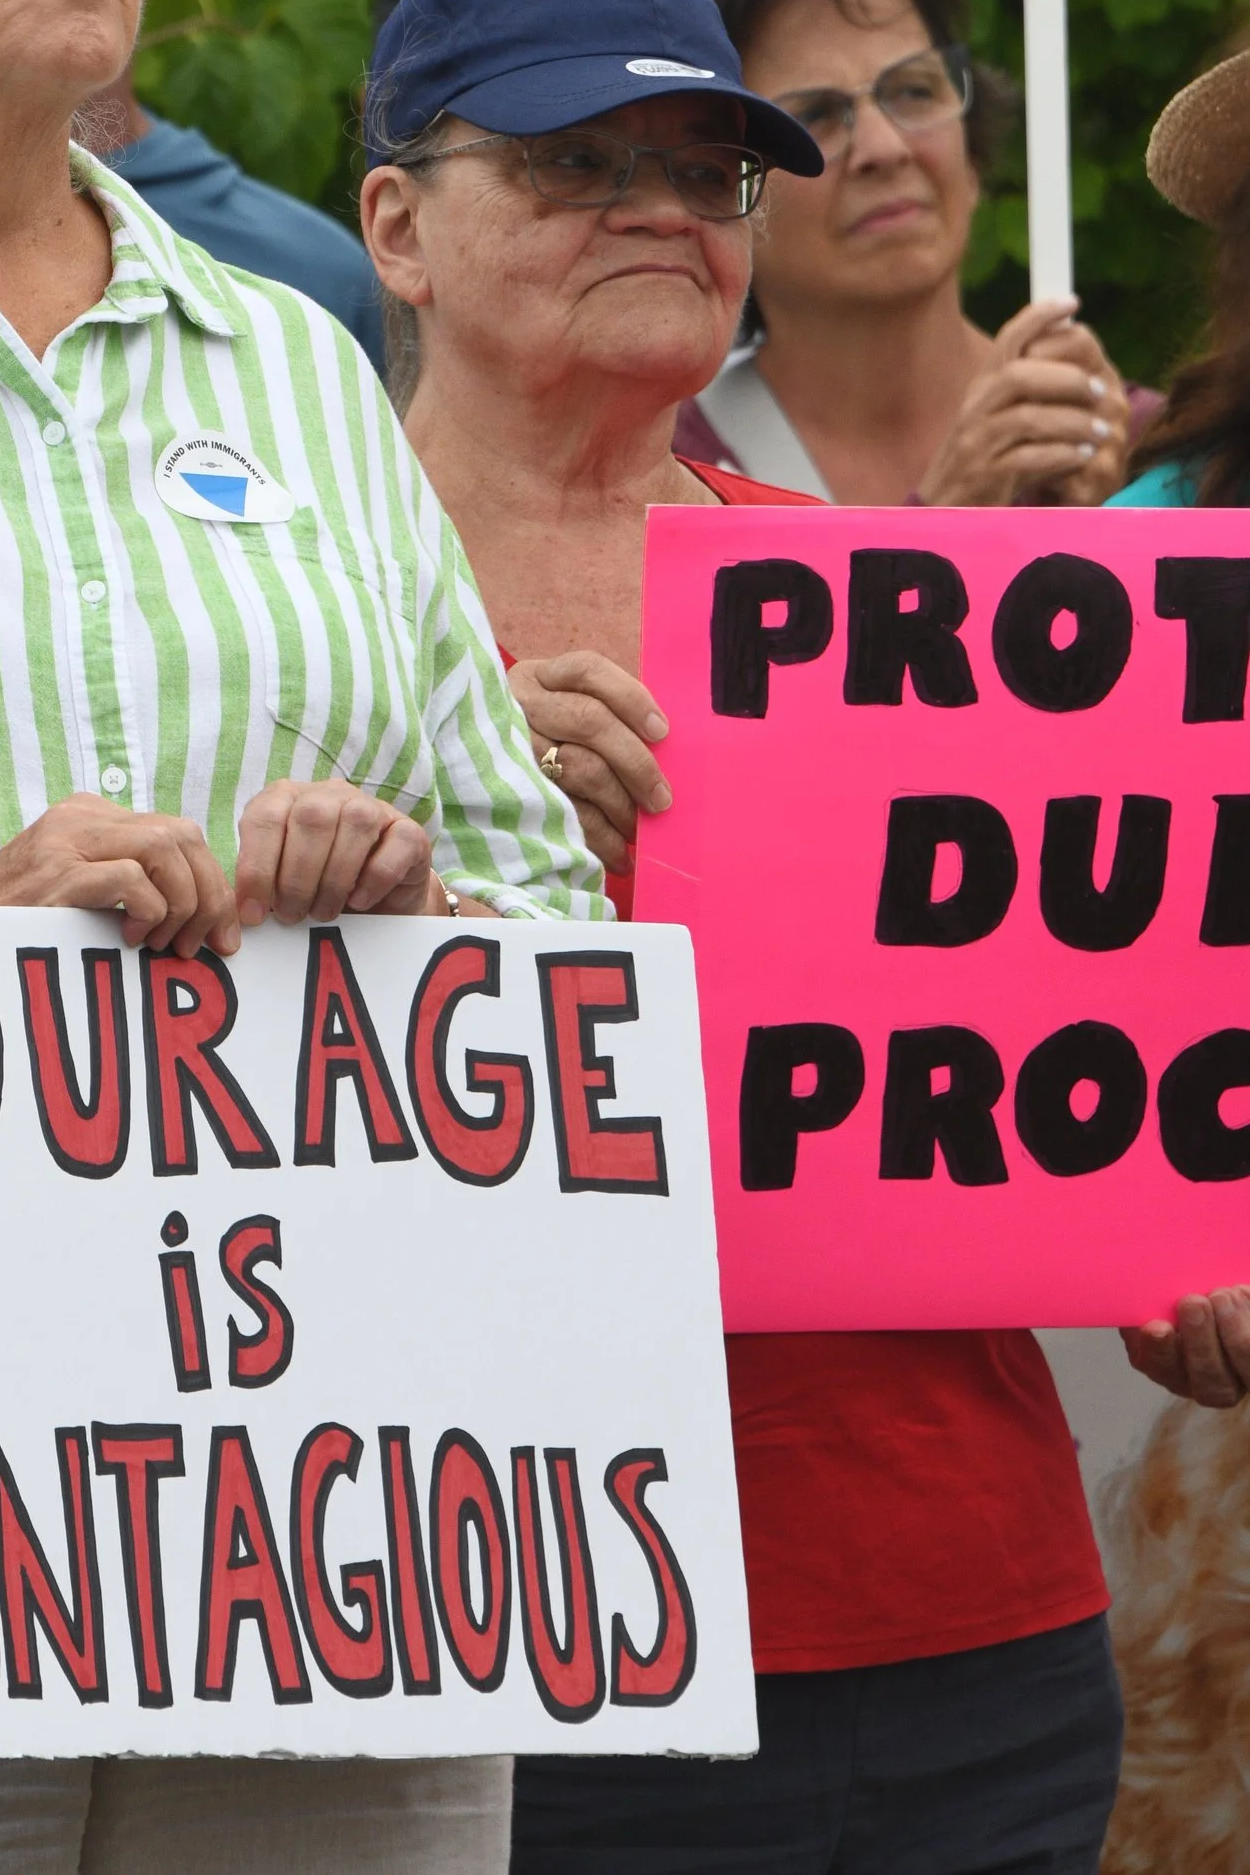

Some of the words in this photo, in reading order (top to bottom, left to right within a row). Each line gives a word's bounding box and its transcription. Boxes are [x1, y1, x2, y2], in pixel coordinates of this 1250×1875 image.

[165, 446, 185, 473] STAND
[185, 439, 209, 452] WITH
[211, 440, 267, 486] IMMIGRANTS
[710, 548, 1250, 724] PROT
